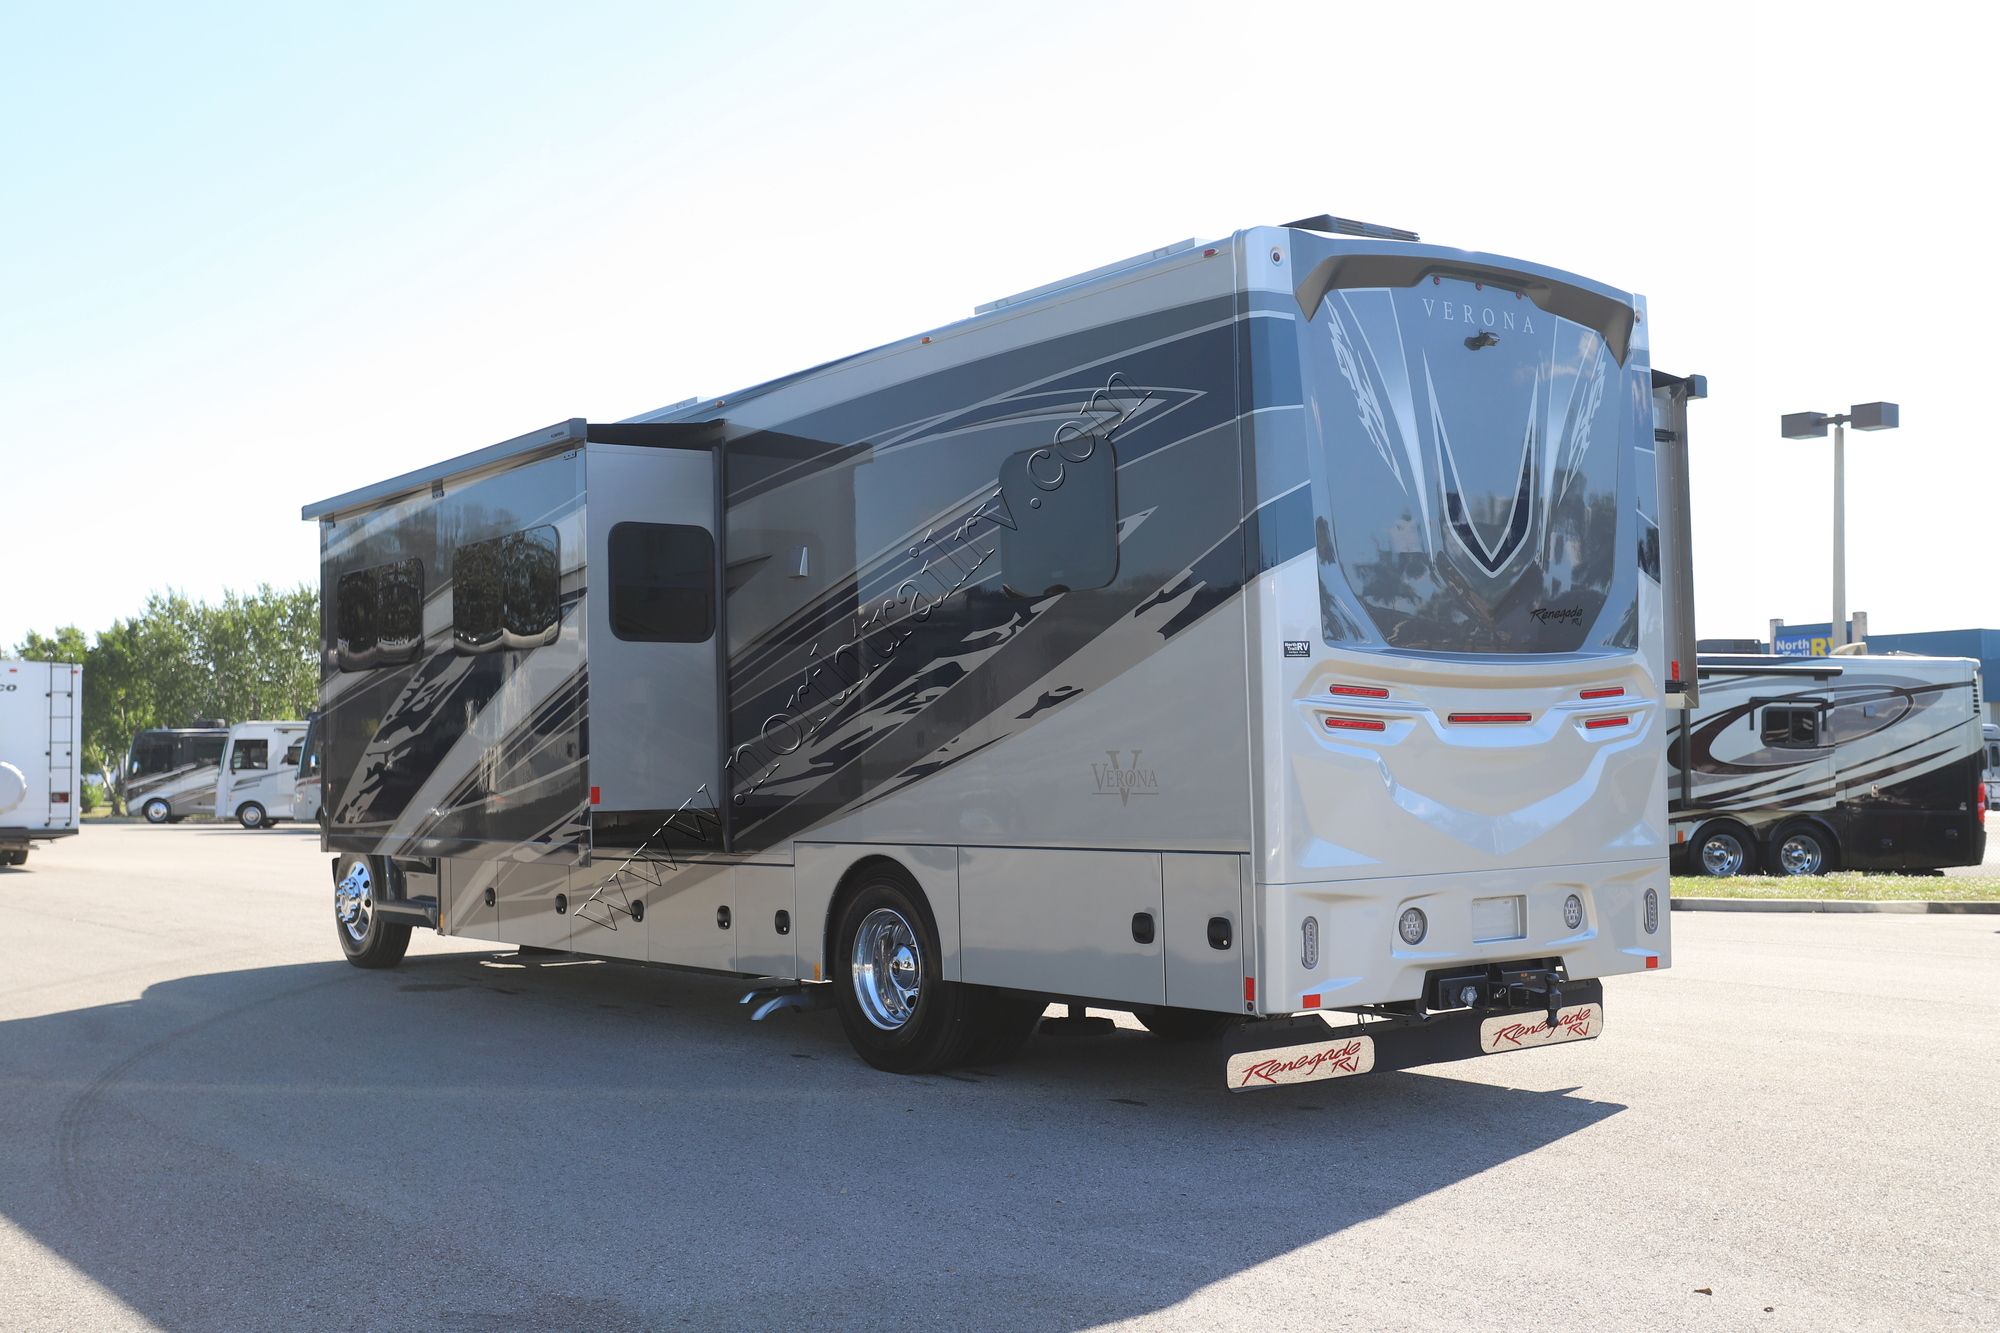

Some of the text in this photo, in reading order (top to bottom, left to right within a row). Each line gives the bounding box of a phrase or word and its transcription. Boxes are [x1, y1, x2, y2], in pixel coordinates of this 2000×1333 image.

[1422, 298, 1534, 334] VERONA
[1530, 604, 1583, 625] Renegade
[1297, 642, 1309, 651] RV
[1776, 638, 1810, 651] North
[1091, 763, 1158, 792] VERONA
[1567, 1022, 1590, 1036] RV
[1241, 1040, 1361, 1086] Renegade
[1331, 1056, 1360, 1073] RV
